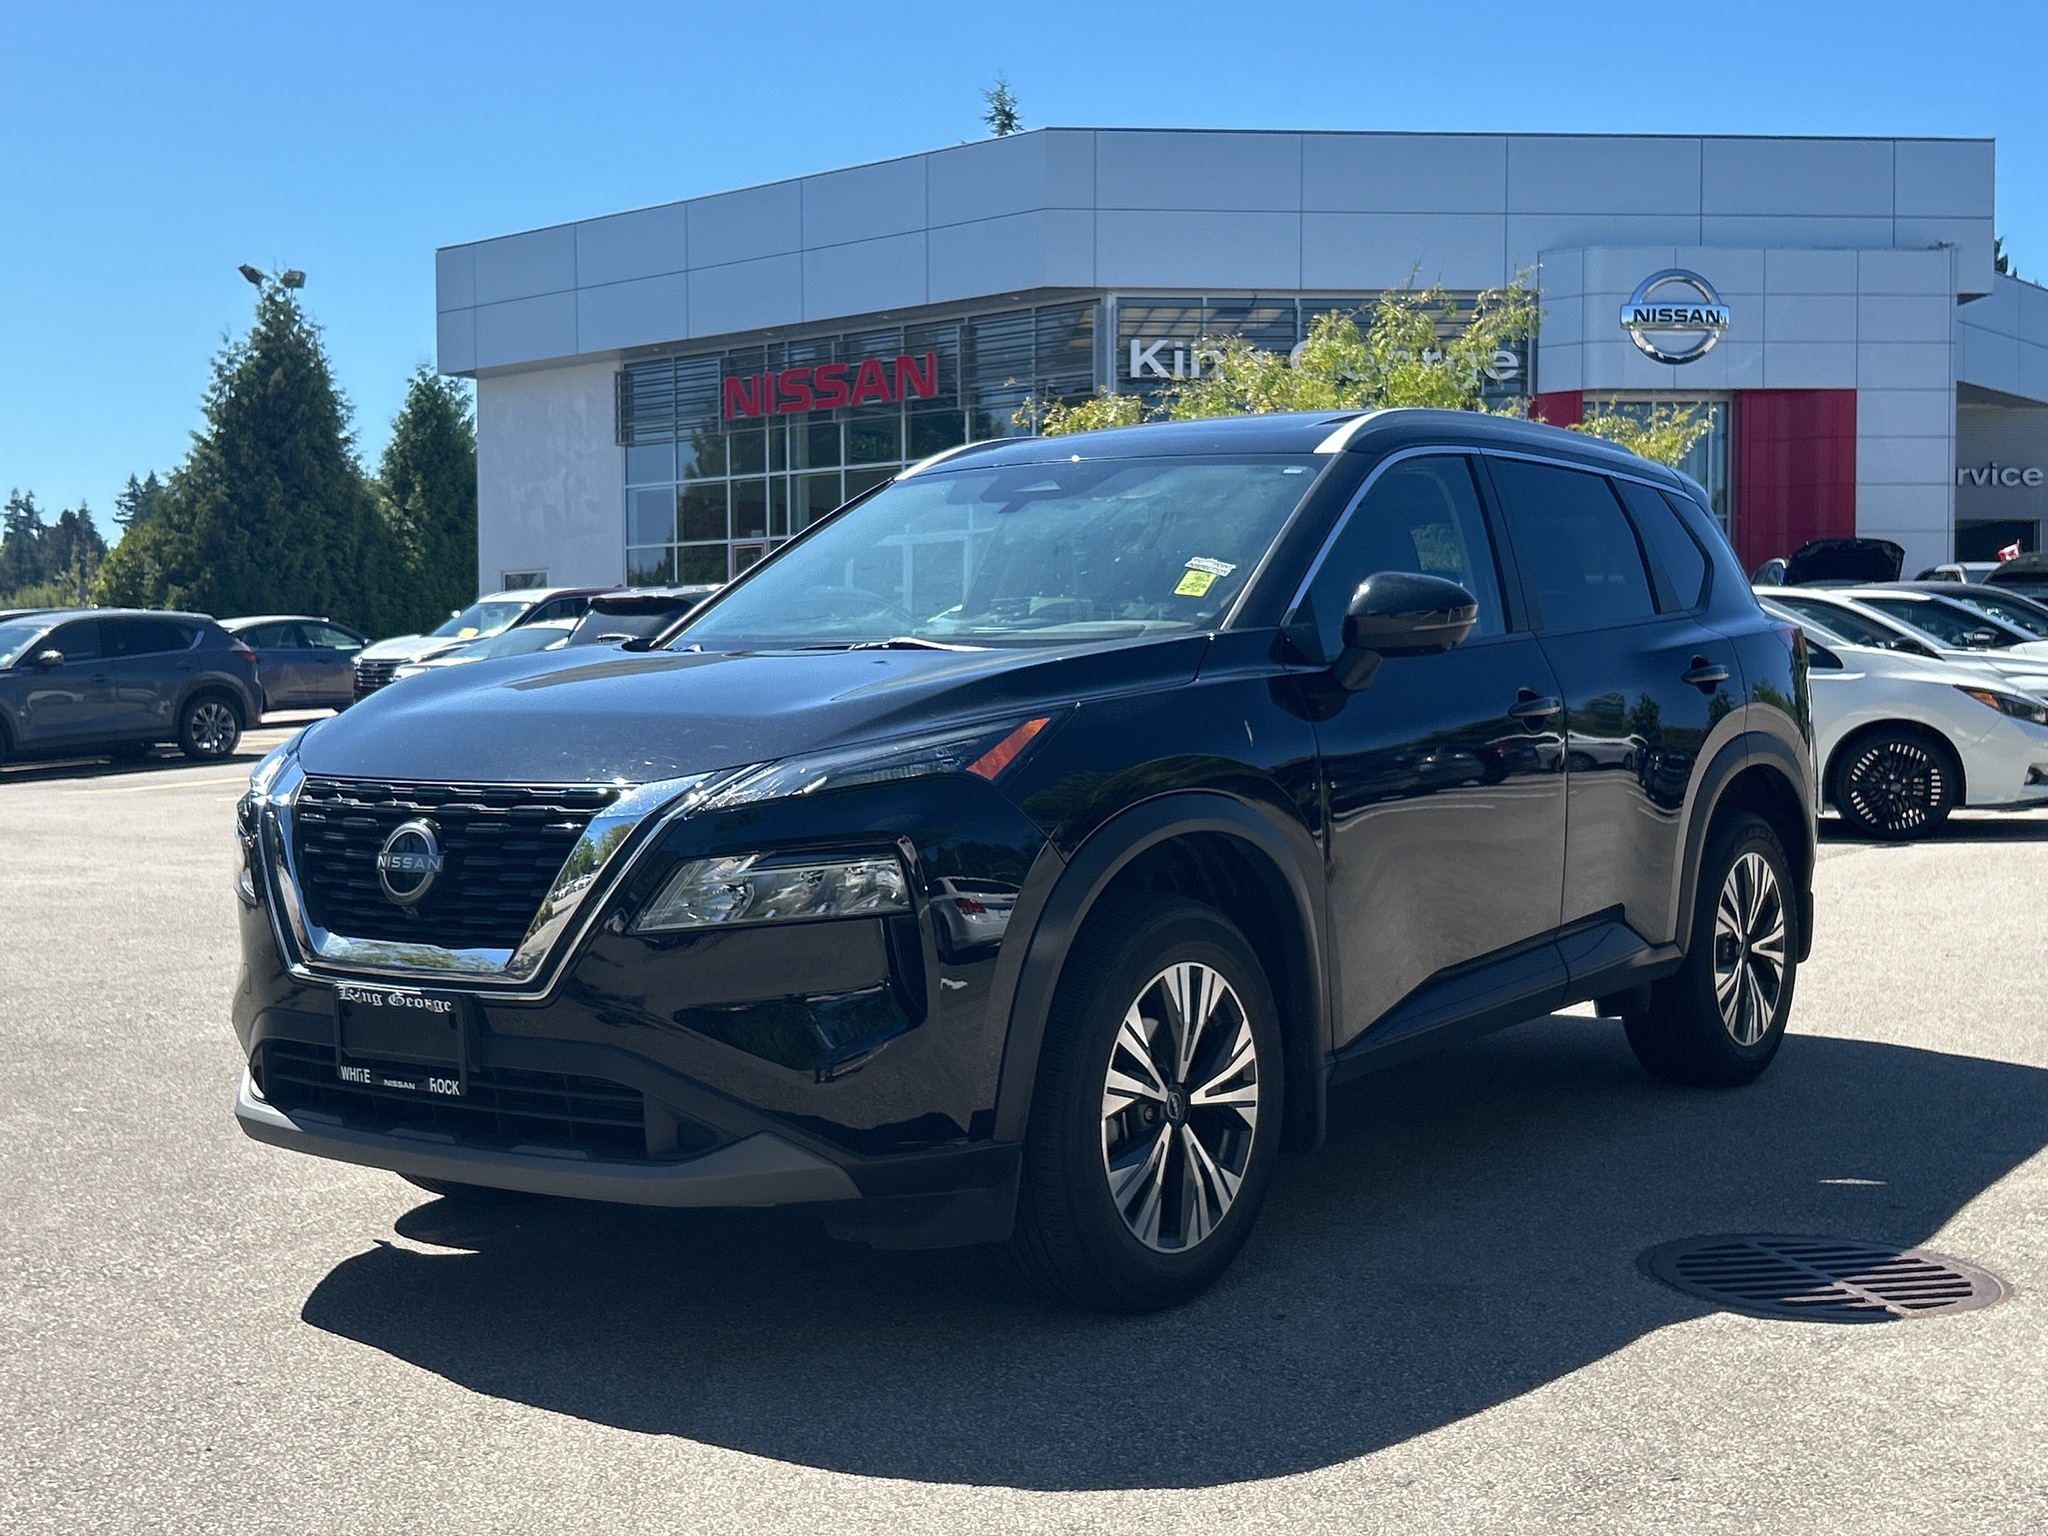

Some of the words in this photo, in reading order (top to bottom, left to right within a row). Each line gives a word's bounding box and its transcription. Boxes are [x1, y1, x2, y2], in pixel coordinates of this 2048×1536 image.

[1633, 308, 1720, 323] NISSAN
[1130, 339, 1264, 384] Kin
[723, 352, 937, 420] NISSAN
[1957, 462, 2044, 487] rvice
[377, 855, 441, 869] NISSAN
[388, 993, 452, 1013] George
[384, 1079, 416, 1090] NISSAN
[429, 1078, 460, 1095] ROCK
